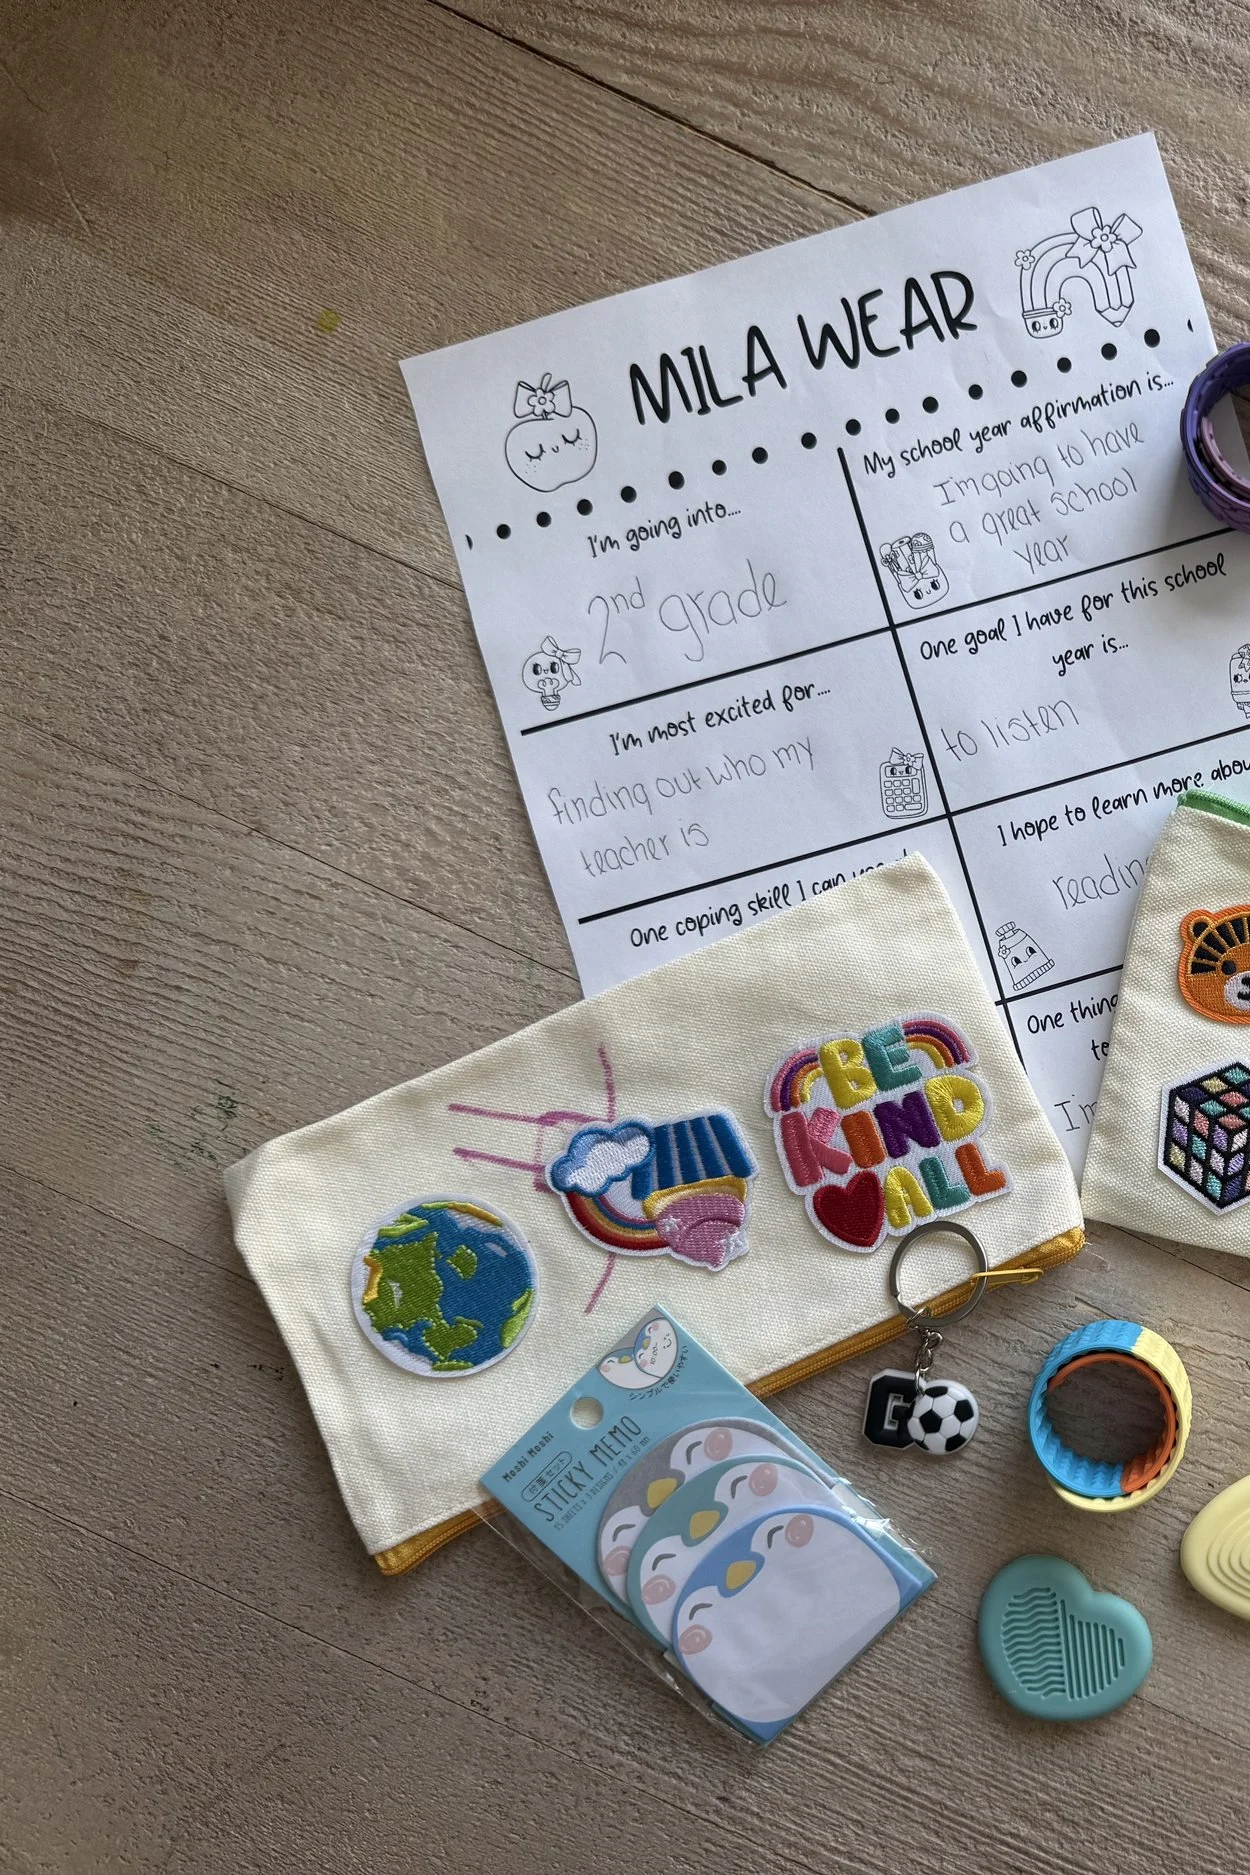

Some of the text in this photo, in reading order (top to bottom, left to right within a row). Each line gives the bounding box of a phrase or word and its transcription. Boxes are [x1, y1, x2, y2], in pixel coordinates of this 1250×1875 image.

[629, 270, 978, 425] MILA WEAR
[863, 453, 897, 478] My
[900, 428, 961, 467] school
[969, 420, 1013, 453] year
[1020, 380, 1143, 434] affirmation
[1058, 443, 1085, 469] to
[1081, 422, 1144, 457] have
[588, 533, 621, 559] I'm
[626, 516, 683, 552] going
[948, 467, 1138, 546] a great school
[588, 558, 788, 665] 2nd grade
[920, 552, 1228, 661] One goal I have for this school
[1052, 641, 1096, 677] year
[609, 732, 643, 756] I'm
[648, 712, 697, 743] most
[705, 690, 775, 728] excited
[940, 698, 1080, 762] to listen
[548, 736, 815, 825] finding out who my
[996, 823, 1007, 847] I
[1010, 813, 1059, 842] hope
[1065, 804, 1087, 827] to
[1092, 787, 1149, 820] learn
[1152, 771, 1205, 800] more
[580, 822, 710, 878] teacher is
[630, 925, 669, 948] One
[675, 903, 743, 937] coping
[747, 883, 790, 916] skill
[1027, 1011, 1065, 1034] One
[819, 1024, 923, 1110] BE
[780, 1075, 986, 1188] KIND
[883, 1143, 1007, 1230] ALL
[502, 1431, 555, 1483] Moshi Moshi
[533, 1414, 643, 1523] STICKY MEMO
